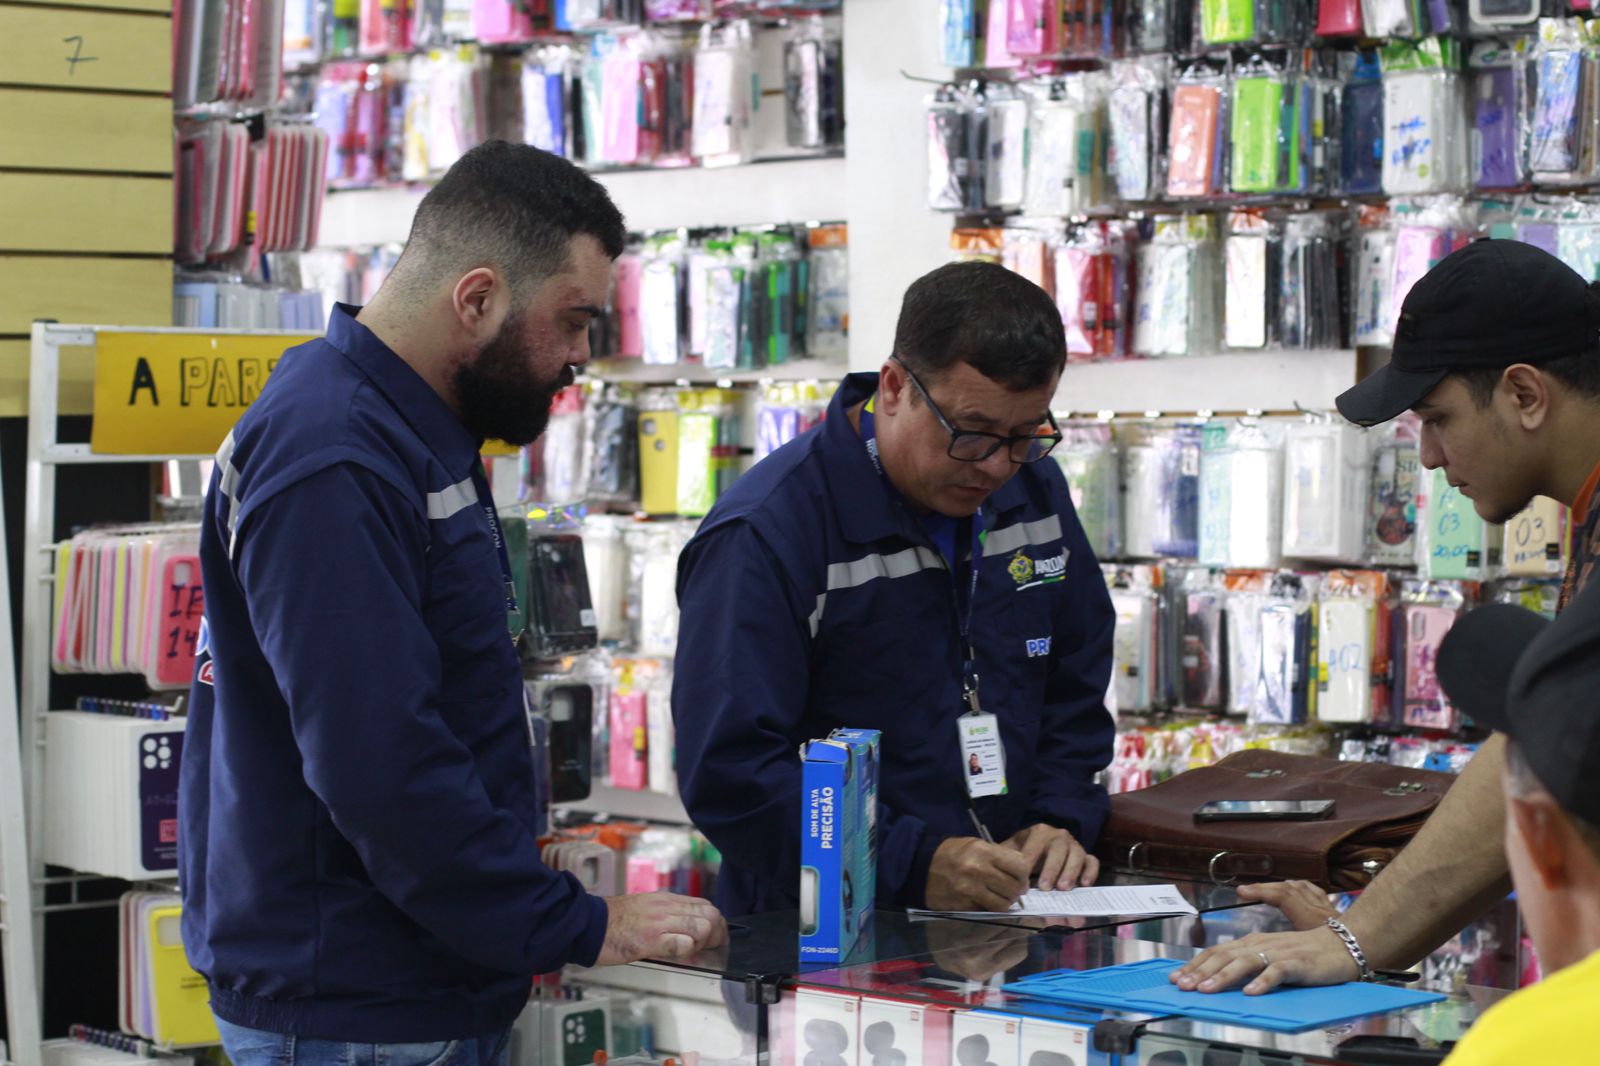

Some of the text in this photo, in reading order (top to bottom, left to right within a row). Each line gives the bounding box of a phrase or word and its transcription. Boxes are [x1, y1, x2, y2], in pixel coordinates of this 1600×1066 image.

[62, 35, 100, 76] 7
[128, 356, 280, 407] A PAR
[1515, 517, 1546, 547] 03
[1026, 637, 1051, 657] PR
[810, 788, 819, 808] ALTA
[810, 809, 819, 819] DE
[819, 786, 834, 849] PRECISÃO
